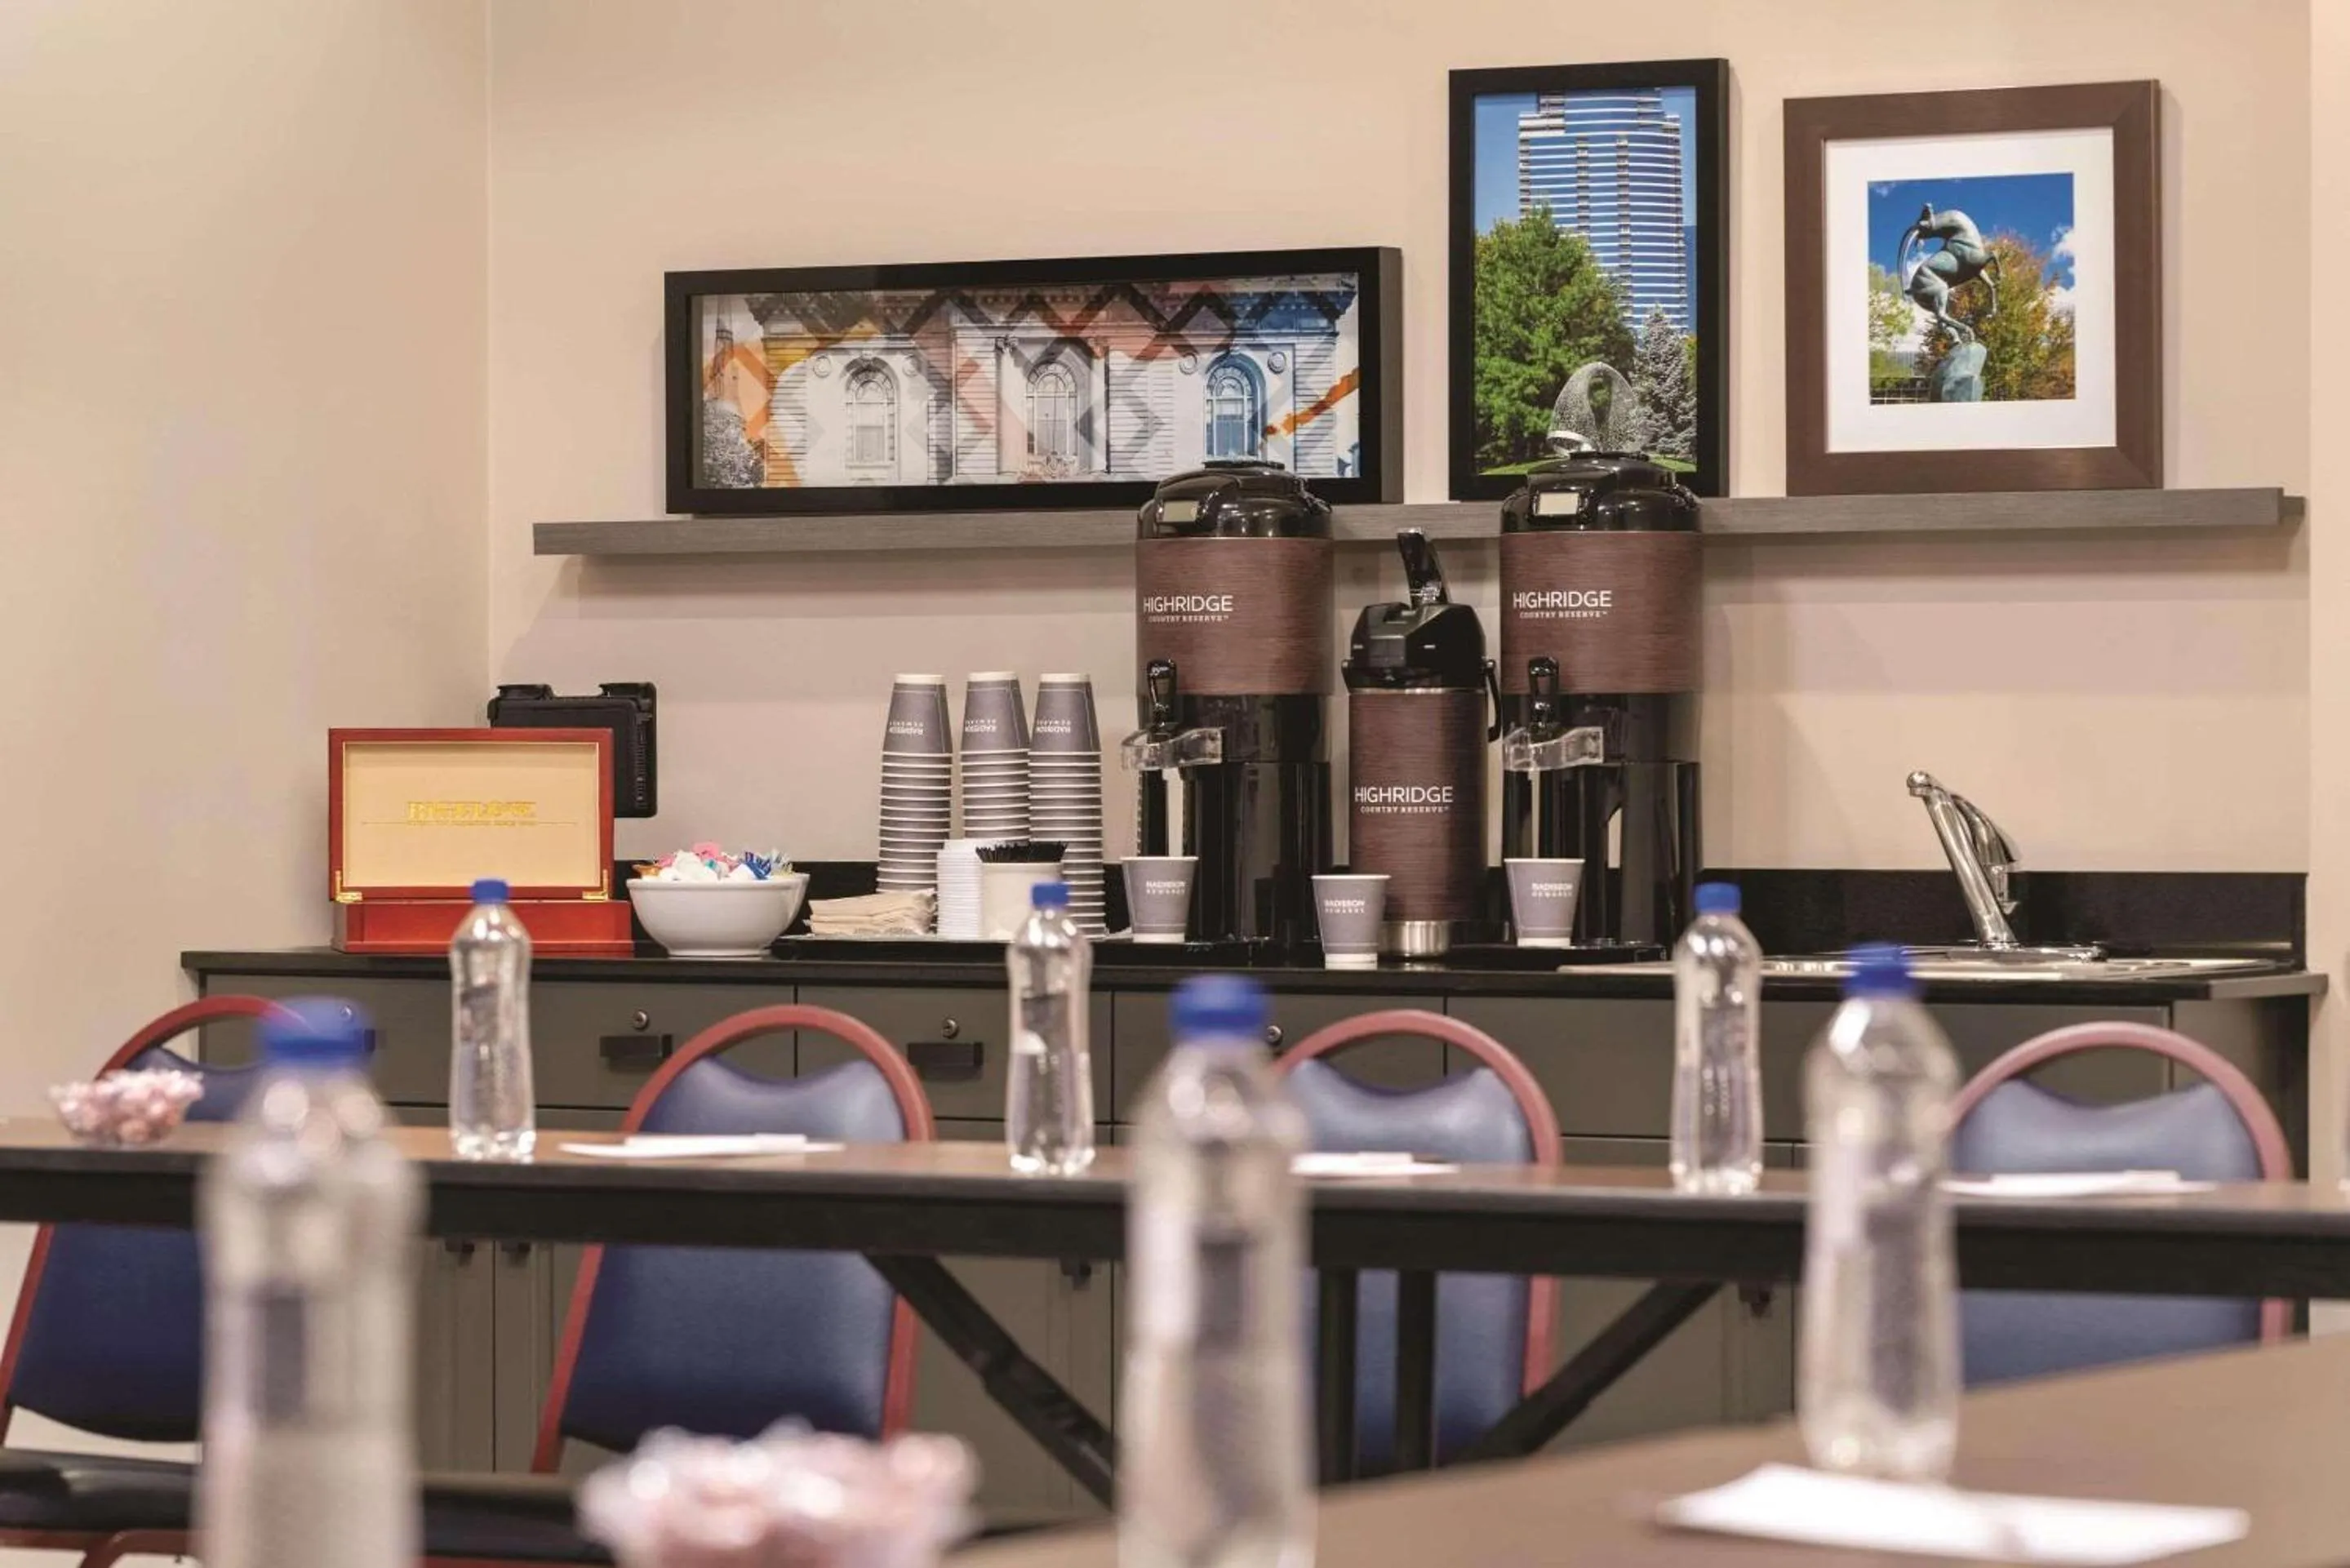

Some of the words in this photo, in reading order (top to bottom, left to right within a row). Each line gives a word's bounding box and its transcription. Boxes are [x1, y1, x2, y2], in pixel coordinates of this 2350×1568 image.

[1143, 594, 1233, 613] HIGHRIDGE
[1513, 590, 1613, 609] HIGHRIDGE
[1354, 785, 1454, 803] HIGHRIDGE
